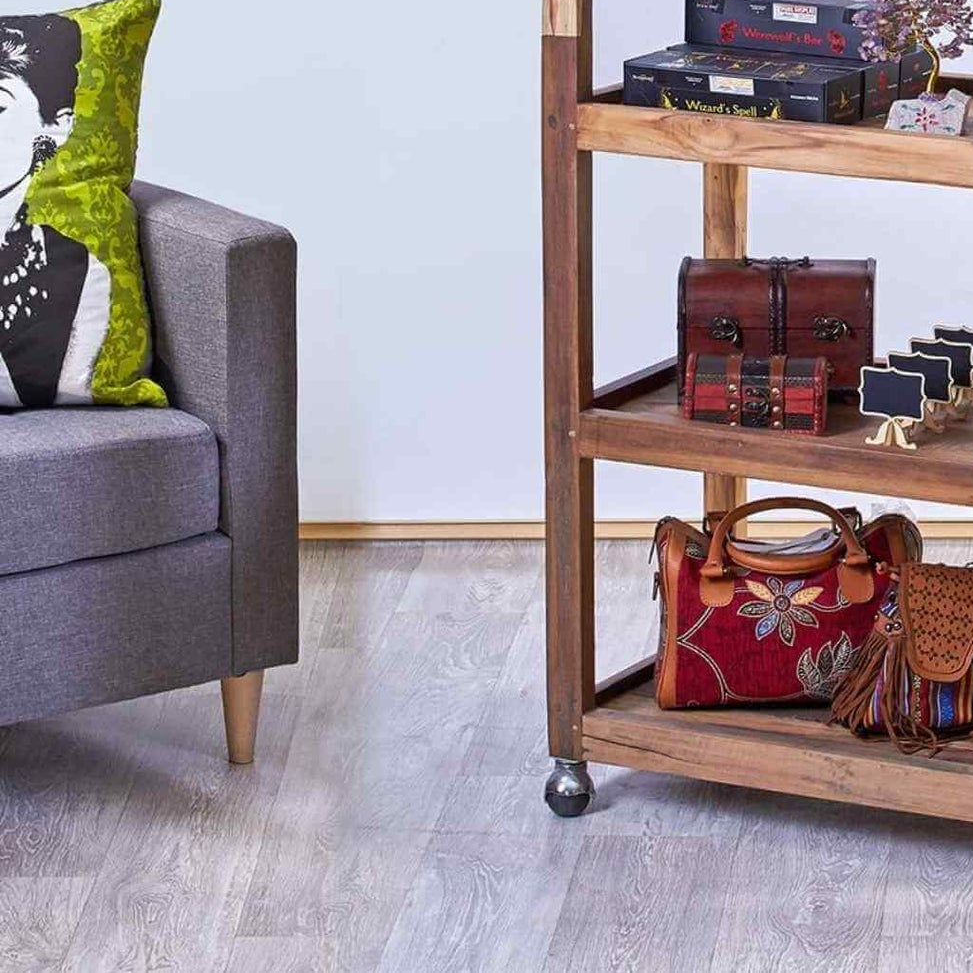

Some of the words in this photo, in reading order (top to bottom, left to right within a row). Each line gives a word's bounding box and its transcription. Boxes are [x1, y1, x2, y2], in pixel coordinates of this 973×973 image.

[742, 26, 801, 43] Werewolf's
[686, 99, 731, 114] Wizard's
[733, 104, 757, 117] Spell
